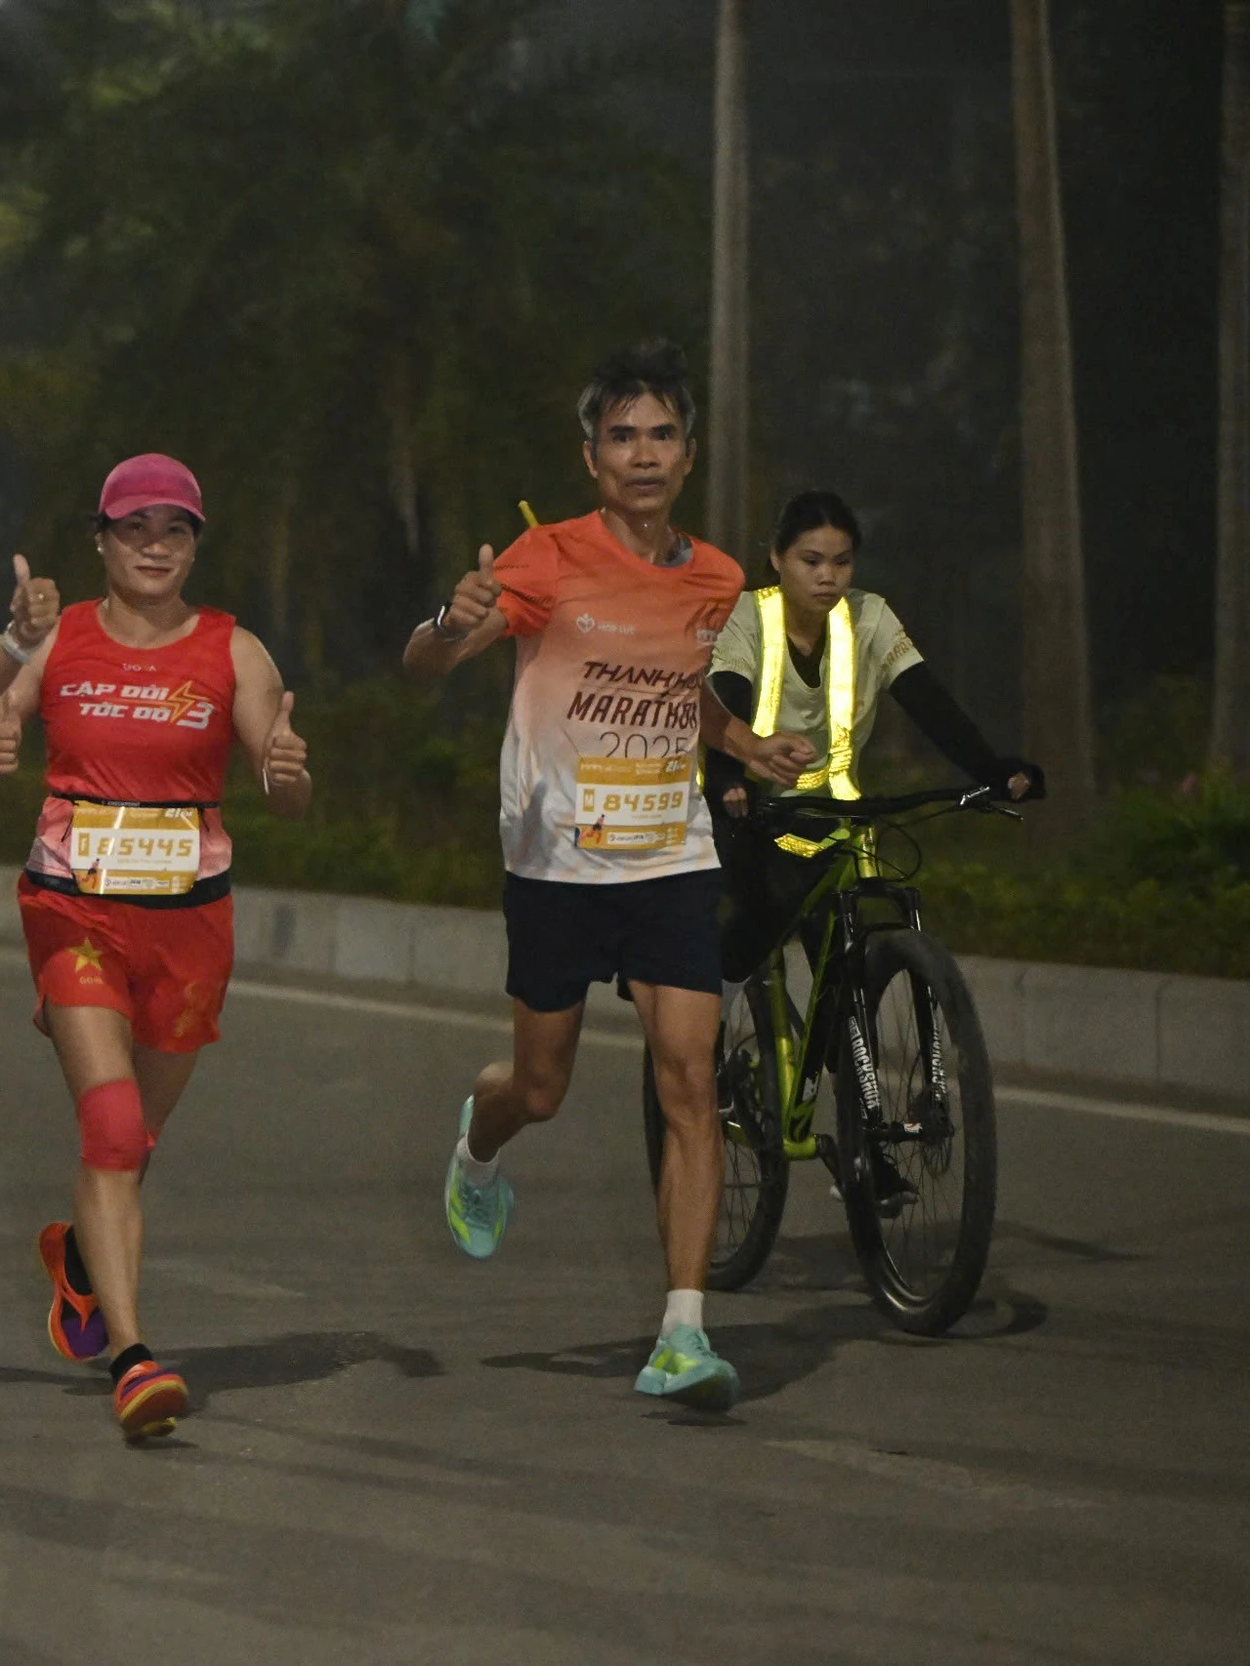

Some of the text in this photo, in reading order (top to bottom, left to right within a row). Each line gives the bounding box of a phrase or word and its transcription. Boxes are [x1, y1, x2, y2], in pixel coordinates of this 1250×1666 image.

[583, 661, 674, 687] THANH
[176, 701, 215, 729] 3
[567, 691, 697, 730] MARATHON
[603, 791, 684, 812] 84599
